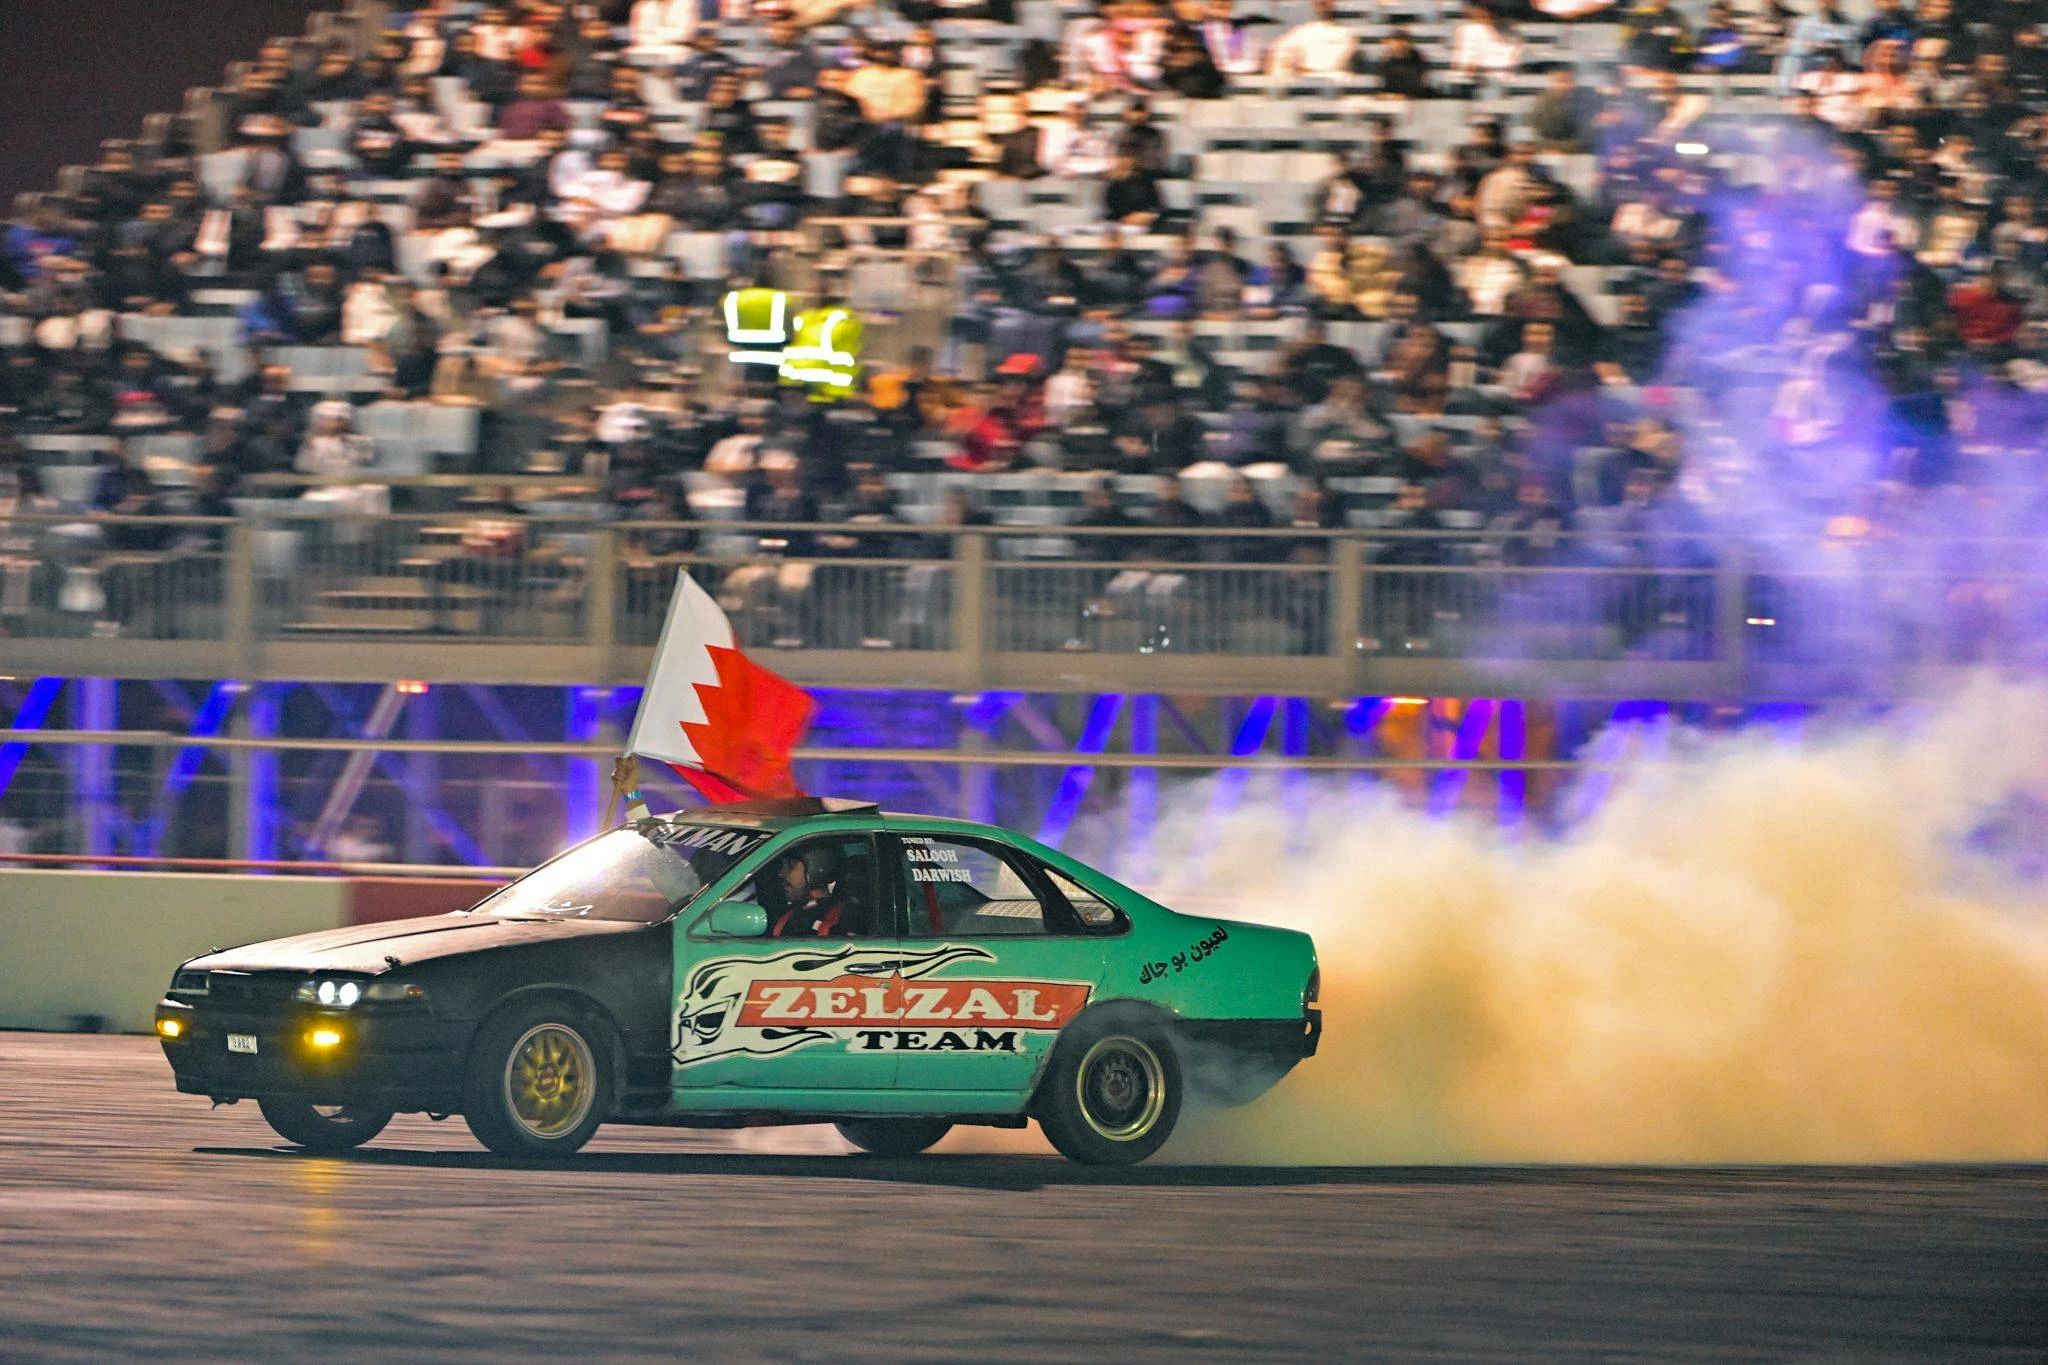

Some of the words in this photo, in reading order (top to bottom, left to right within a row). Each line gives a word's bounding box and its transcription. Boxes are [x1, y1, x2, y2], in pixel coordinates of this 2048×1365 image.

[906, 849, 958, 862] SALOOH
[912, 868, 972, 882] DARWISH
[1171, 951, 1188, 973] بو
[759, 986, 1056, 1022] ZELZAL
[856, 1030, 1017, 1051] TEAM
